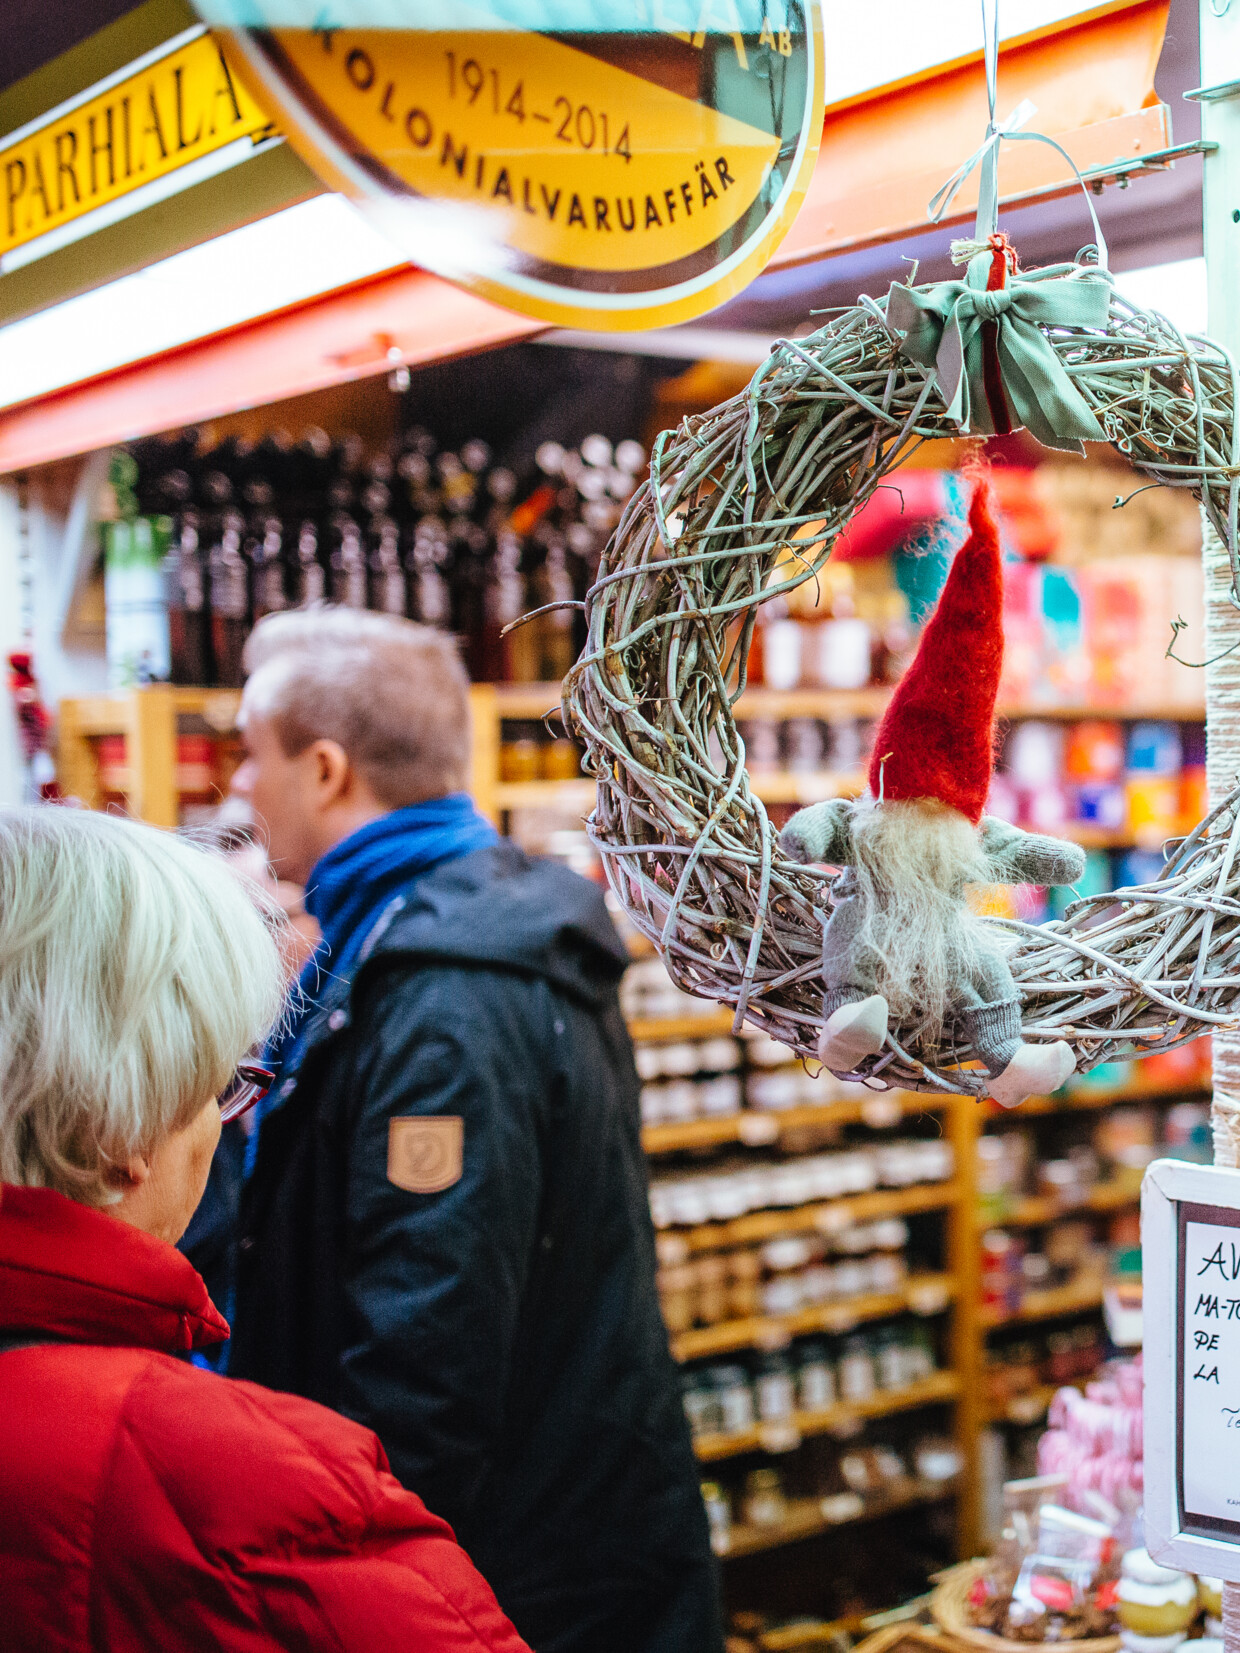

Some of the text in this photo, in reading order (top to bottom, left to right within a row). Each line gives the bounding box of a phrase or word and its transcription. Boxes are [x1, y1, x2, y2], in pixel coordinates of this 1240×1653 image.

[758, 16, 793, 57] AB
[4, 44, 243, 237] PARHIALA
[1194, 1330, 1220, 1351] PE
[1193, 1364, 1219, 1384] LA
